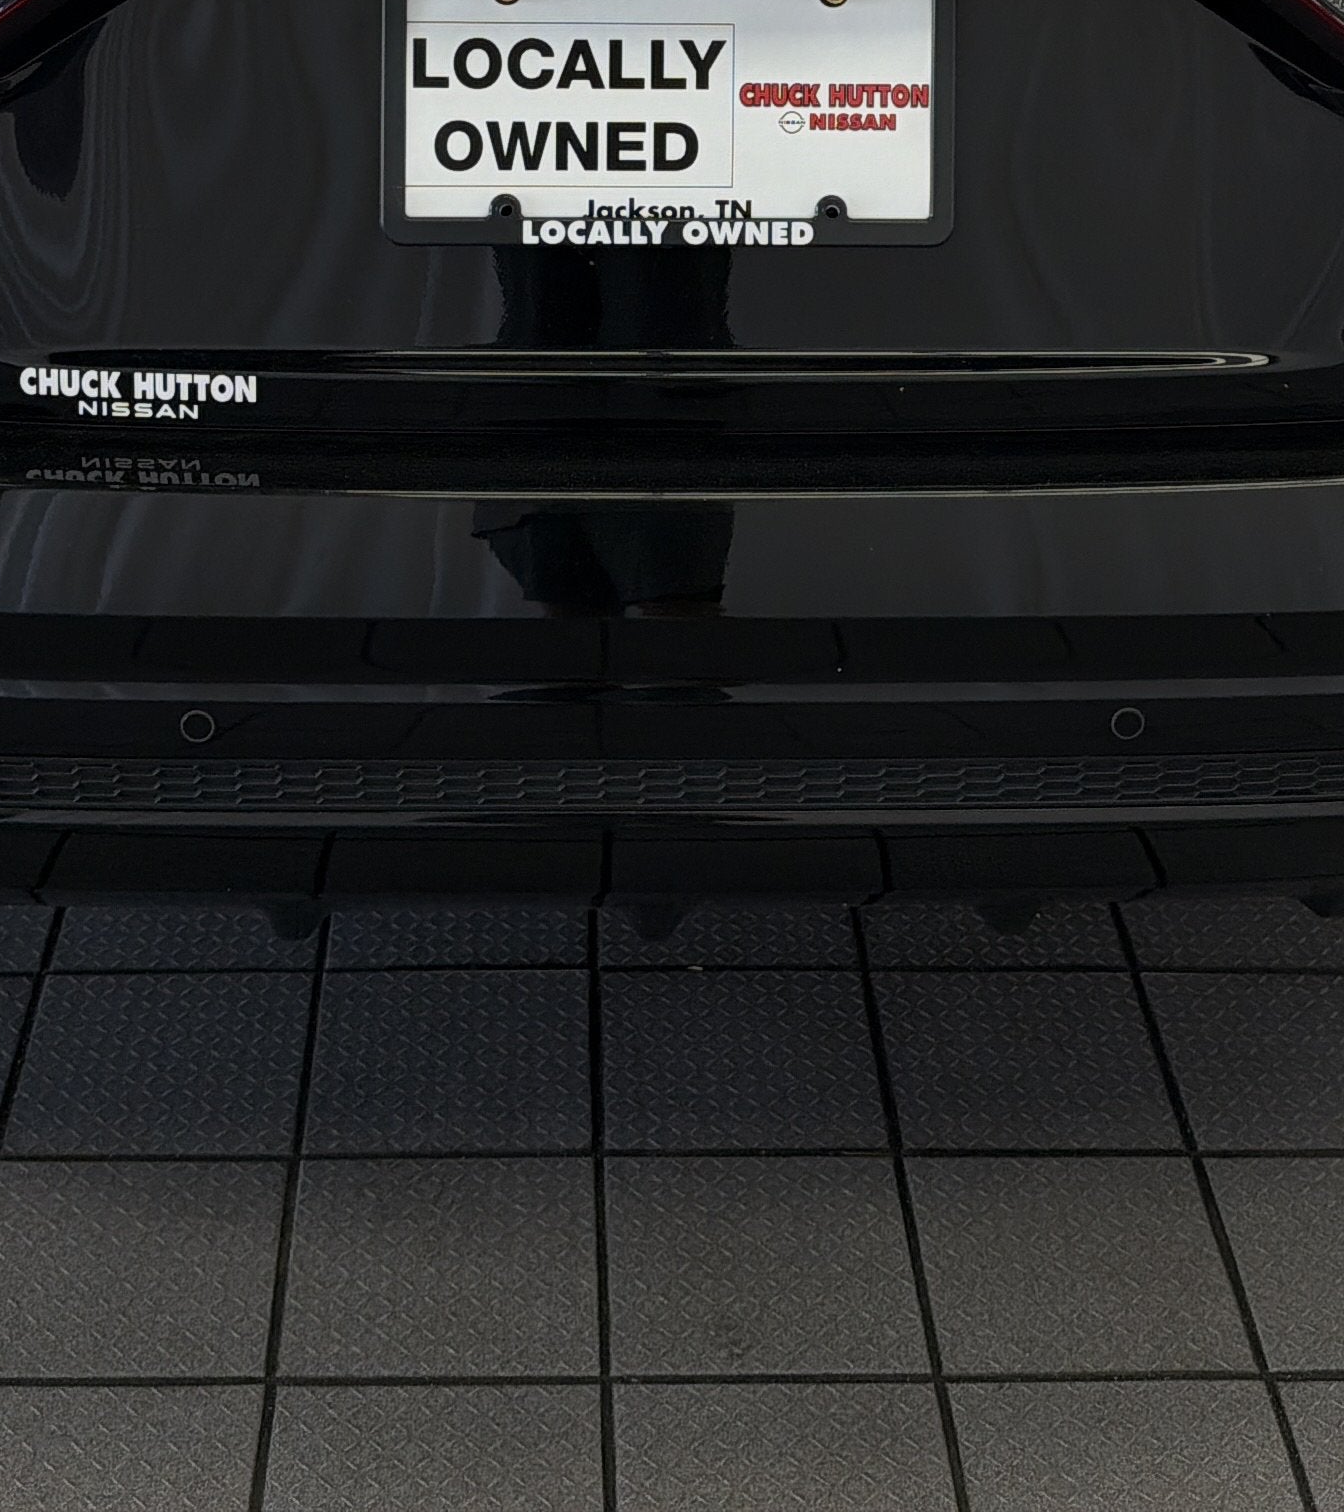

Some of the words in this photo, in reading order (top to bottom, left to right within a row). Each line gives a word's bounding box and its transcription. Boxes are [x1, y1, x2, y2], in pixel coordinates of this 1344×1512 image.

[411, 37, 727, 90] LOCALLY
[739, 83, 821, 107] CHUCK
[828, 84, 929, 108] HUTTON
[809, 113, 896, 131] NISSAN
[433, 120, 700, 172] OWNED
[714, 200, 752, 219] TN
[522, 220, 669, 245] LOCALLY
[682, 221, 814, 246] OWNED
[19, 367, 122, 399] CHUCK
[133, 372, 256, 403] HUTTON
[78, 400, 199, 420] NISSAN
